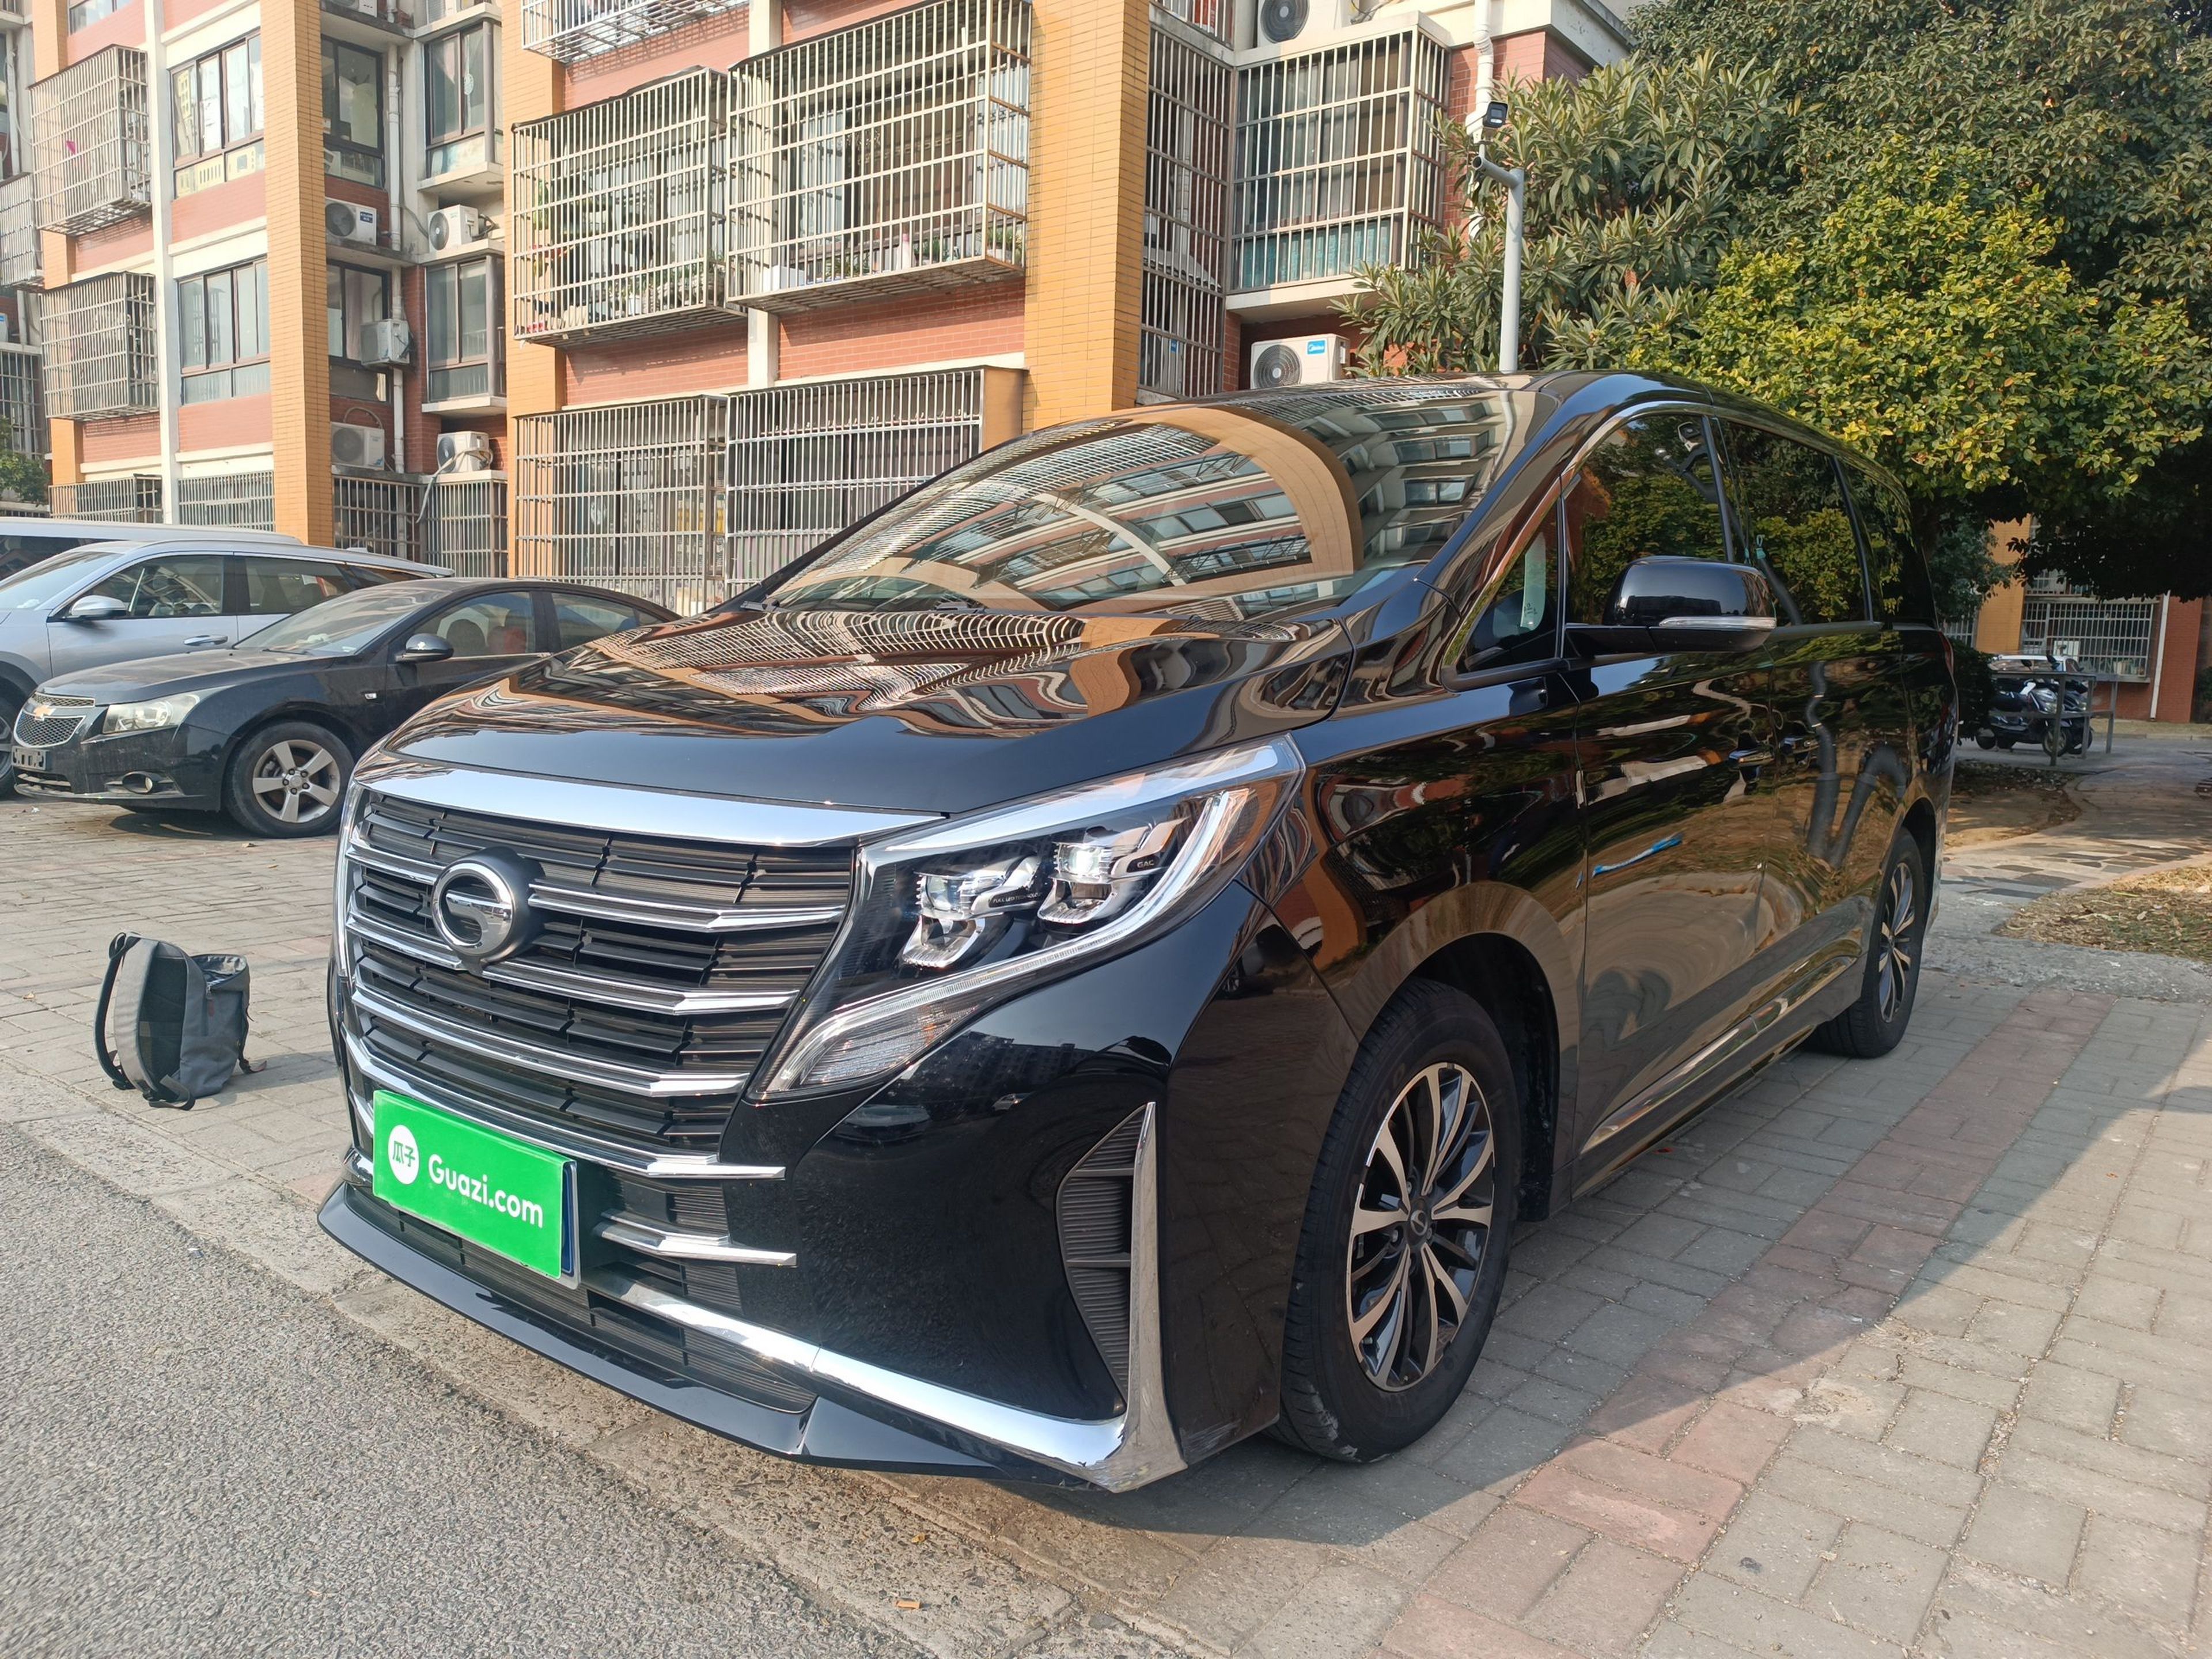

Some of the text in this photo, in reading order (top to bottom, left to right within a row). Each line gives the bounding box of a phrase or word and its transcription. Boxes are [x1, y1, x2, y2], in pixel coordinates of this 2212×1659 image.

[1137, 859, 1154, 868] GAC
[392, 1141, 415, 1167] 瓜子
[428, 1154, 543, 1228] Guazi.com
